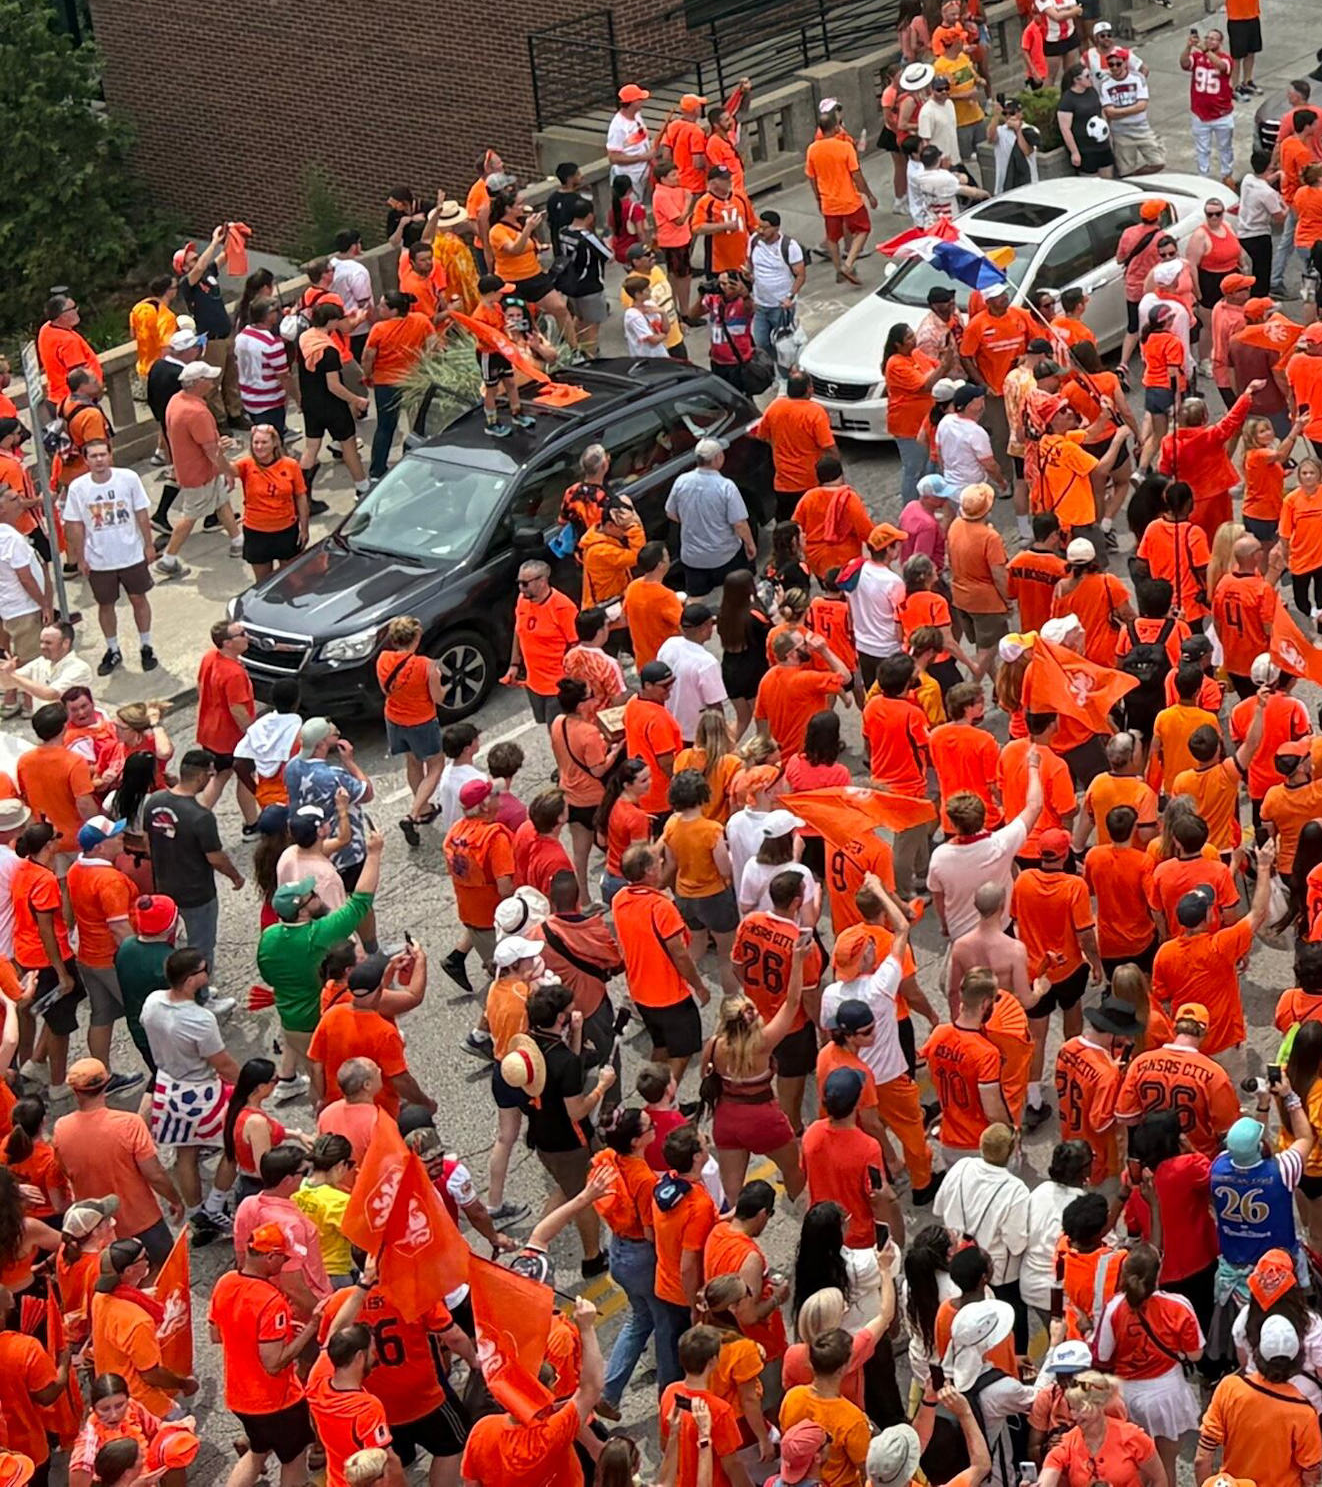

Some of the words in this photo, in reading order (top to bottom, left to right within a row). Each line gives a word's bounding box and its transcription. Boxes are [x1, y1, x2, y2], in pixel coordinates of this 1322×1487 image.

[1195, 66, 1221, 94] 95
[1225, 600, 1244, 639] 4
[741, 939, 785, 995] 26
[934, 1065, 971, 1110] 10
[1137, 1060, 1181, 1076] KANSAS
[1181, 1063, 1215, 1083] CITY
[1139, 1080, 1197, 1134] 26
[1213, 1185, 1270, 1225] 26
